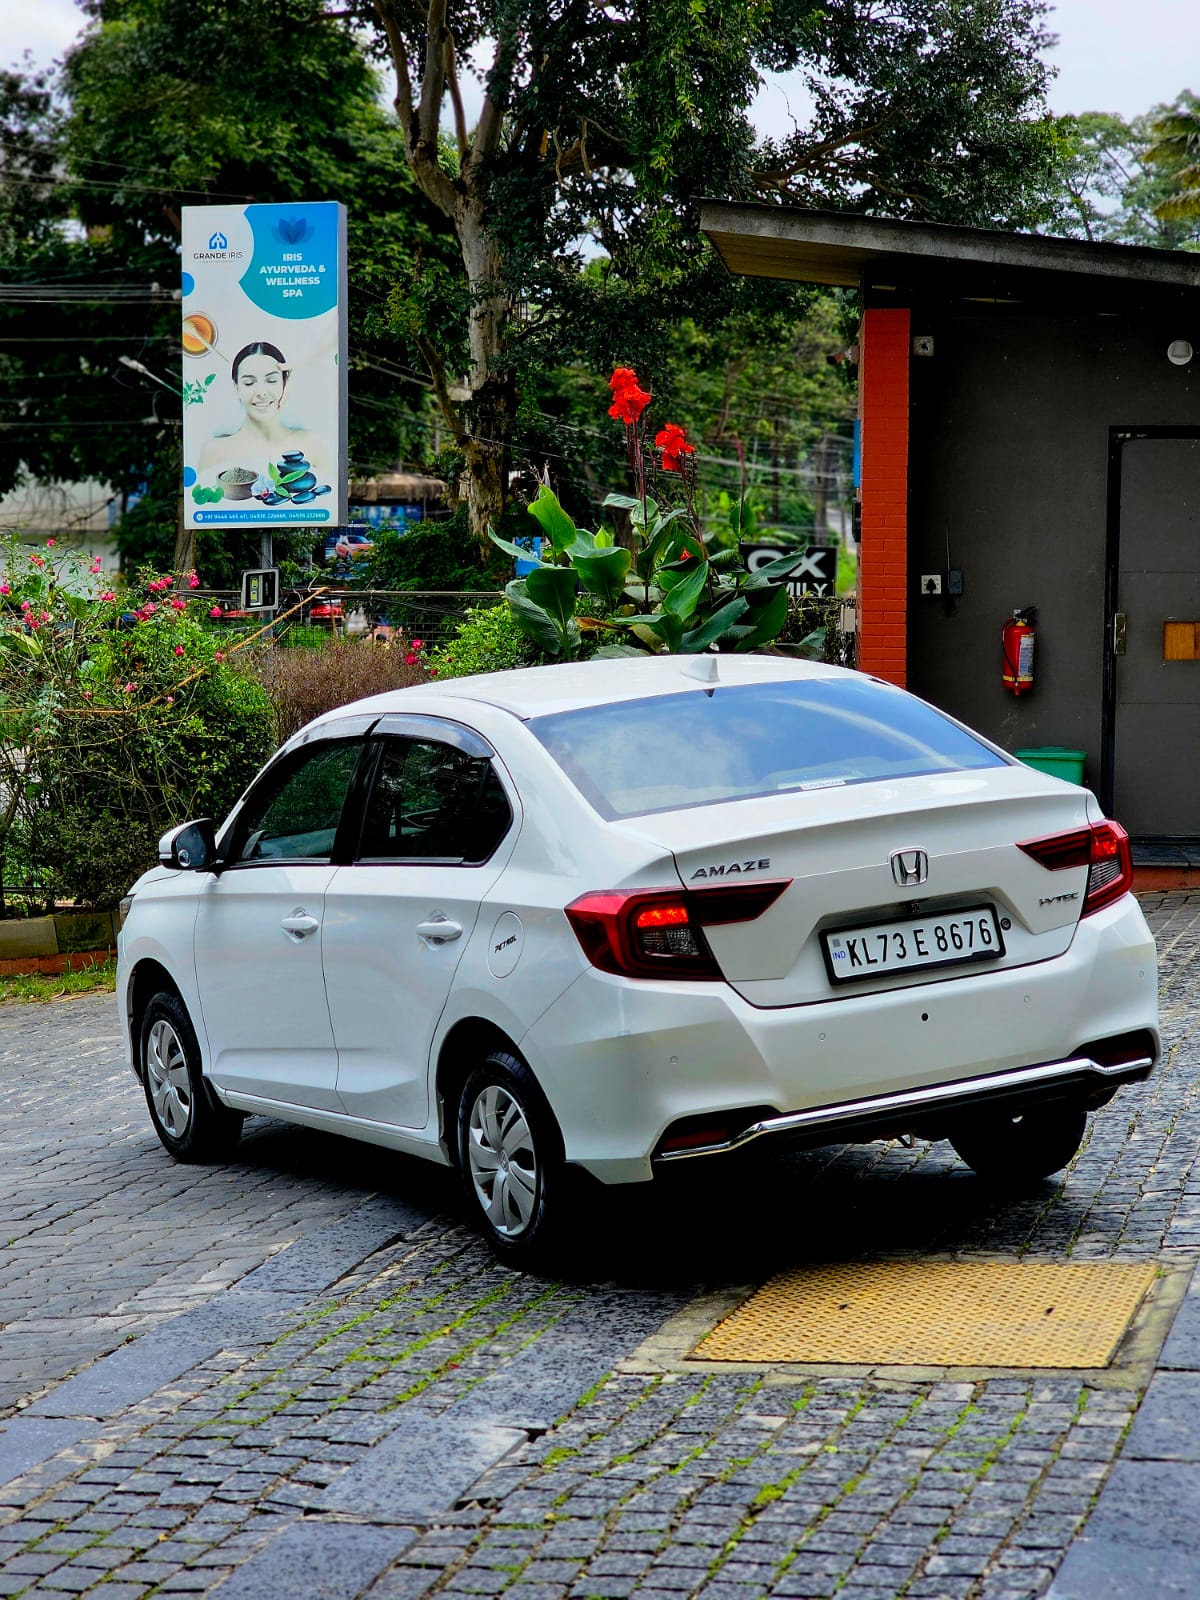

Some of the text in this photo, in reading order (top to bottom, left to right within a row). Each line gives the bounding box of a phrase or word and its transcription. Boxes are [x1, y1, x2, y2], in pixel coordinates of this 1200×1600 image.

[193, 251, 244, 260] GRANDE IRIS
[282, 253, 303, 262] IRIS
[259, 264, 326, 275] AYURVEDA &
[265, 276, 321, 286] WELLNESS
[282, 288, 303, 298] SPA
[690, 858, 771, 880] AMAZE
[846, 918, 992, 968] KL73 E 8676
[832, 950, 846, 960] IND
